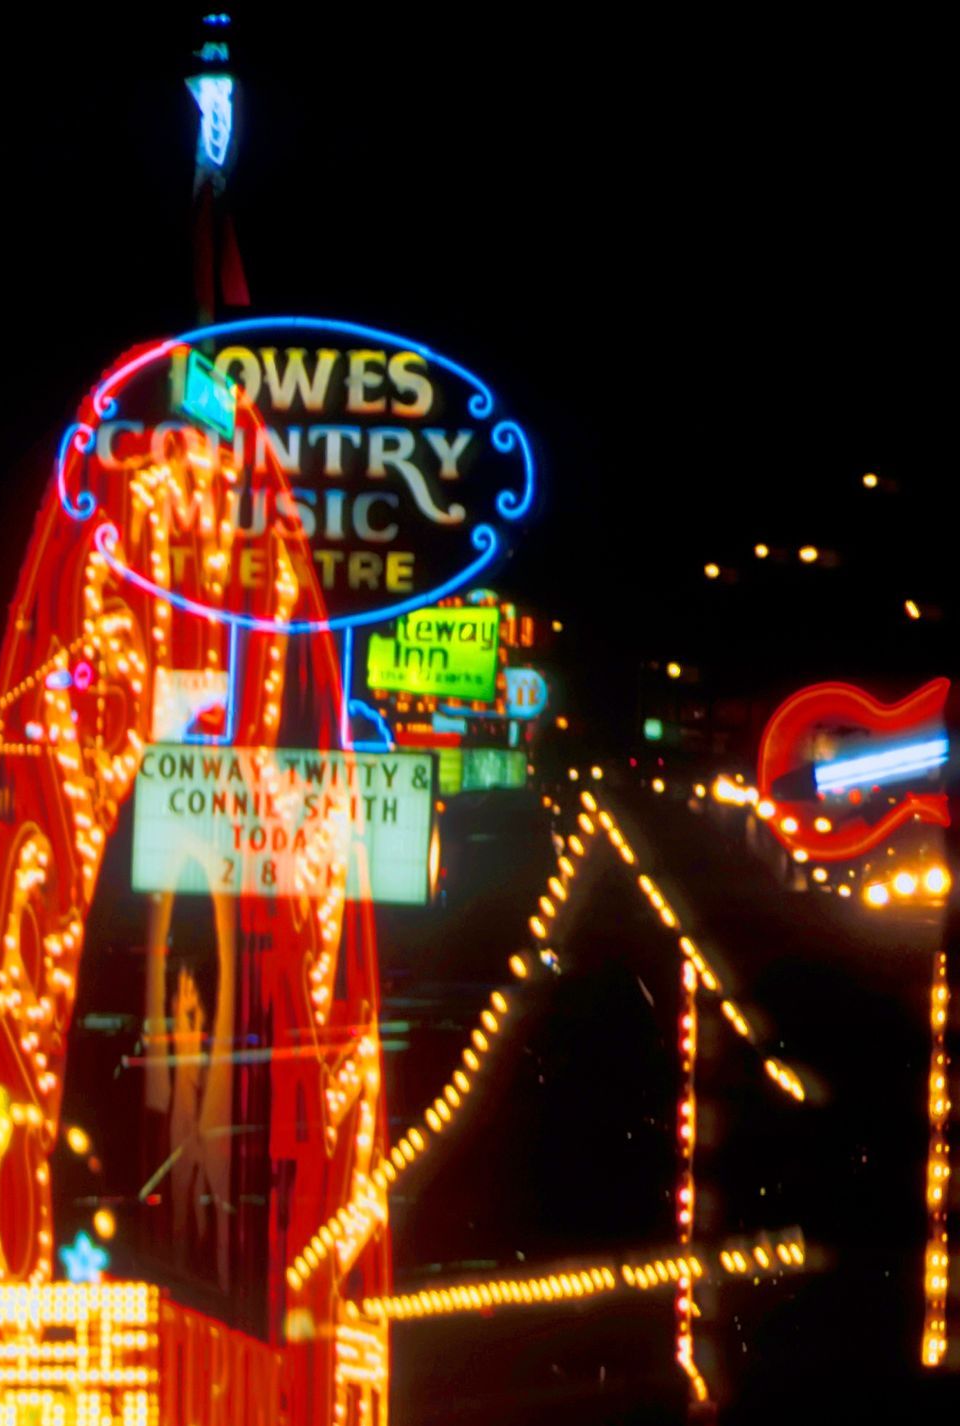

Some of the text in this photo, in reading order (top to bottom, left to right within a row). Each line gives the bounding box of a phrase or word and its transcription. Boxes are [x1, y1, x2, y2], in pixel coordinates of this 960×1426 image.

[166, 546, 416, 593] TETRE
[393, 640, 449, 669] Inn
[233, 825, 328, 853] TODA
